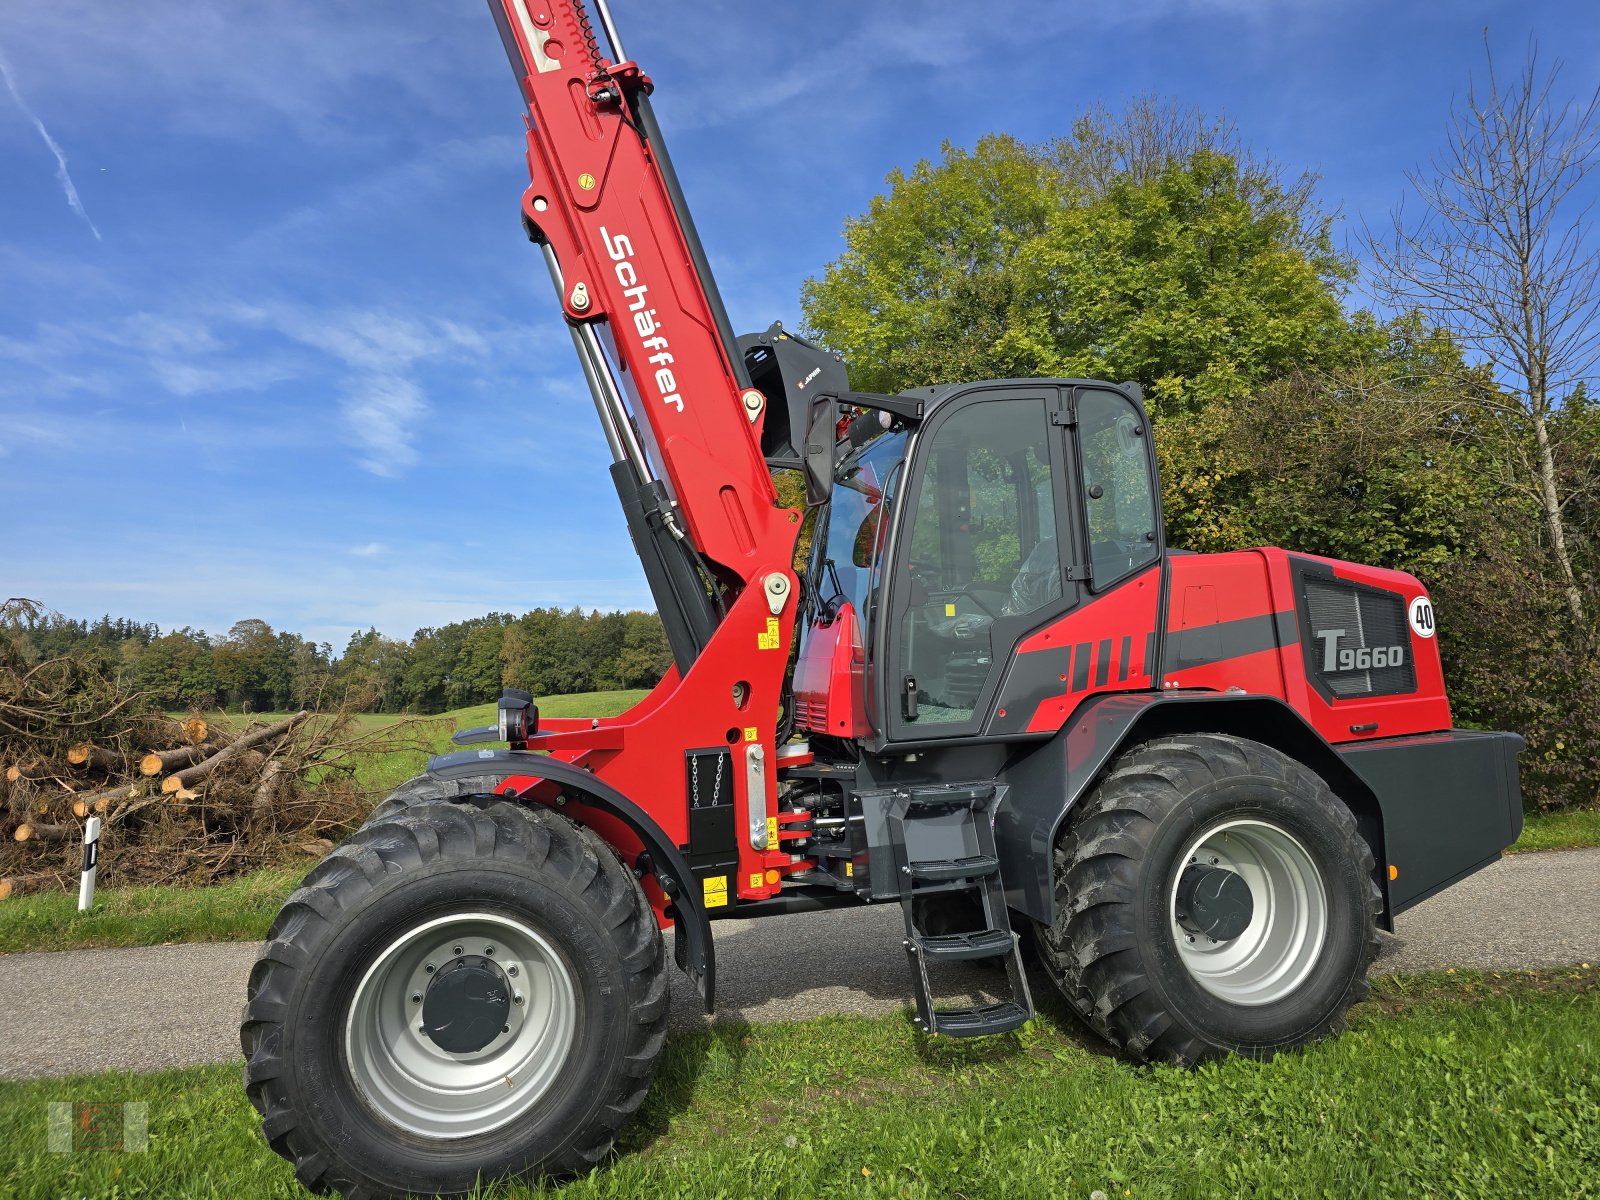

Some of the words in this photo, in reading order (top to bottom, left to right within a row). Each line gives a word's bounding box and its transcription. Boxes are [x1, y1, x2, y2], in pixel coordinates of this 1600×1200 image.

[600, 227, 684, 413] Schäffer
[1416, 605, 1433, 629] 40
[1317, 629, 1403, 672] T9660
